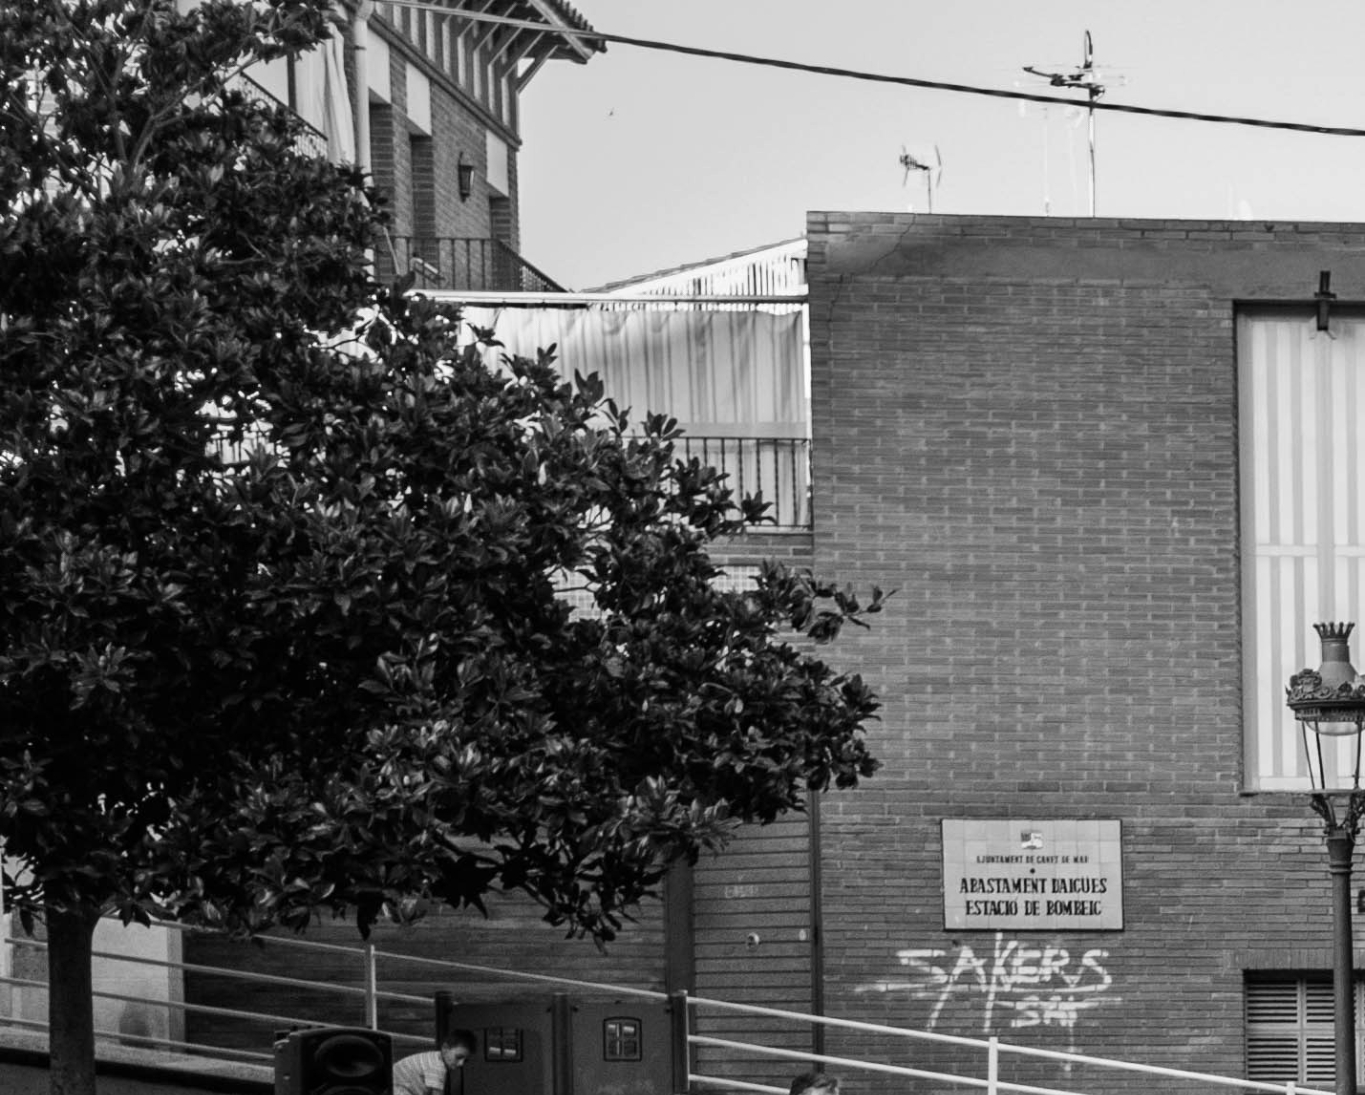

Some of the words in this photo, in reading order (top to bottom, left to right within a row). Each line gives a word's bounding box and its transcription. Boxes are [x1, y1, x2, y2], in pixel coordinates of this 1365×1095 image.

[1025, 855, 1034, 864] DE
[959, 877, 1047, 894] ABASTAMENT
[1024, 900, 1040, 916] DE
